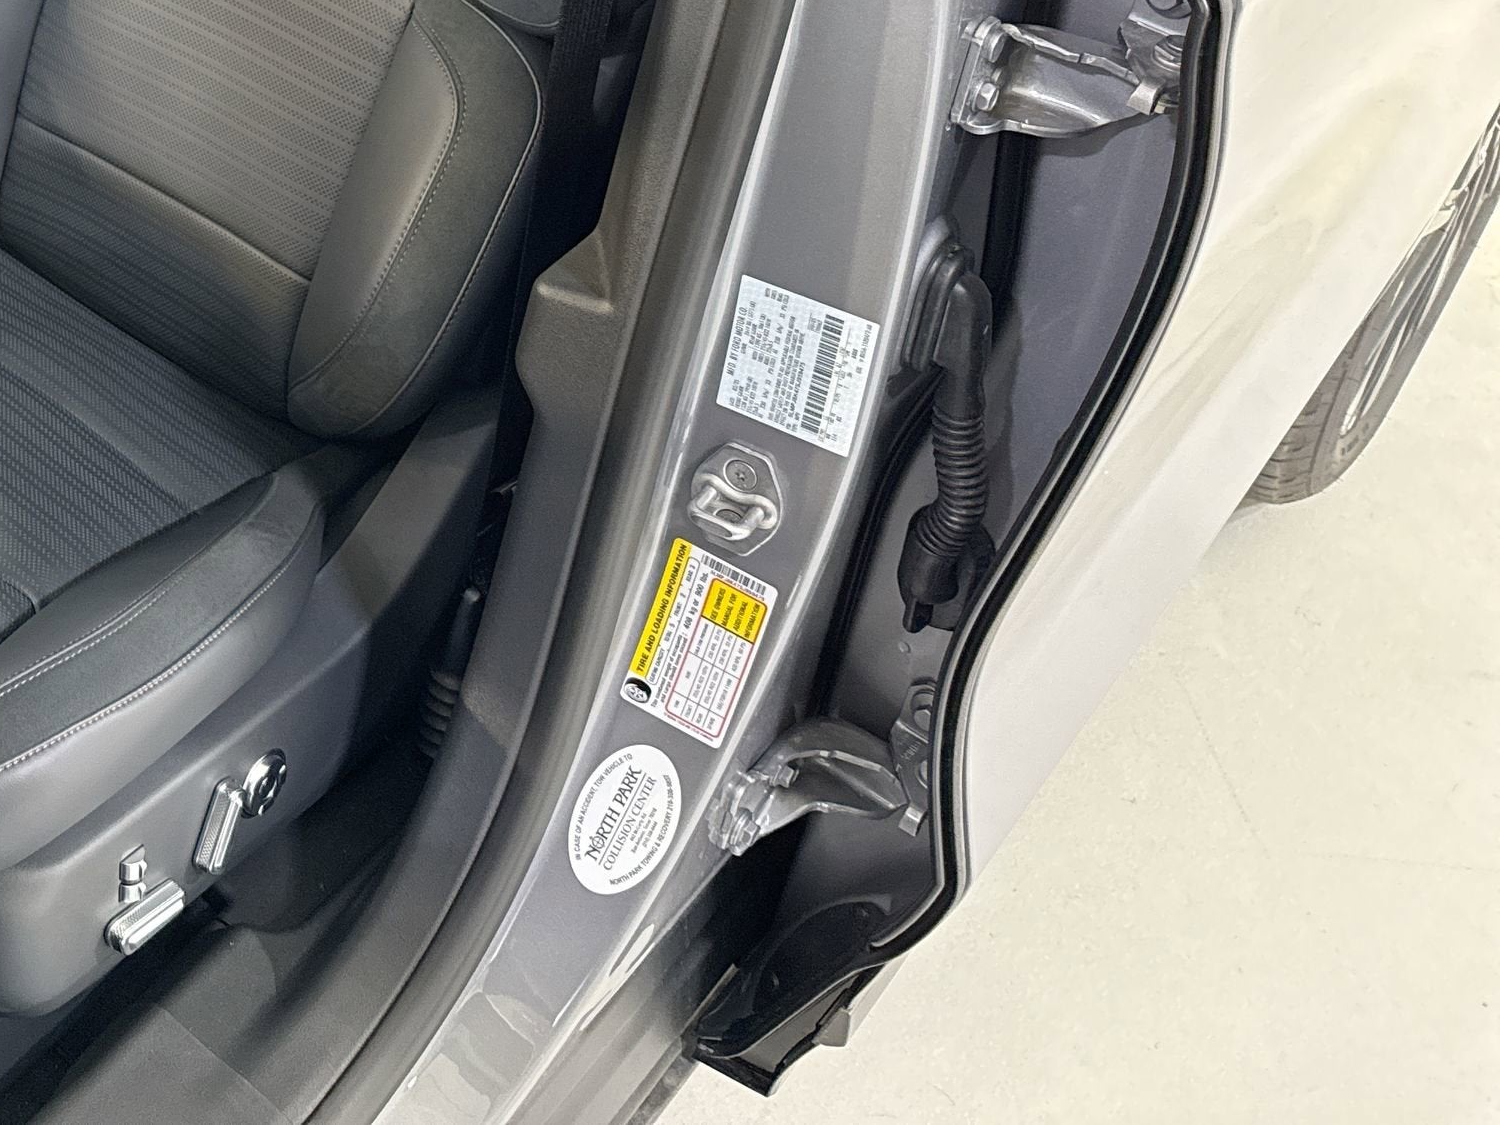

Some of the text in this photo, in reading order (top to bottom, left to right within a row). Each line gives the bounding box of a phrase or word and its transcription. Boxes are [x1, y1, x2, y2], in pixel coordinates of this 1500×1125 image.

[736, 315, 745, 336] MOTOR
[732, 335, 741, 352] FORD
[692, 598, 699, 607] or
[695, 583, 704, 597] 900
[637, 543, 688, 673] TIRE AND LOADING INFORMATION
[683, 615, 692, 629] 408
[688, 605, 698, 616] kg
[710, 609, 718, 620] SEE
[721, 592, 737, 626] MANUAL FOR
[733, 599, 748, 631] ADDITIONAL
[743, 602, 760, 638] INFORMATION
[594, 774, 605, 787] TOW
[603, 757, 624, 776] VEHICLE
[623, 753, 632, 761] TO
[584, 765, 642, 861] NORTH PARK
[603, 776, 657, 870] COLLISION CENTER
[609, 874, 629, 885] NORTH
[628, 865, 643, 877] PARK
[640, 846, 658, 866] TOWING
[657, 811, 672, 842] RECOVERY
